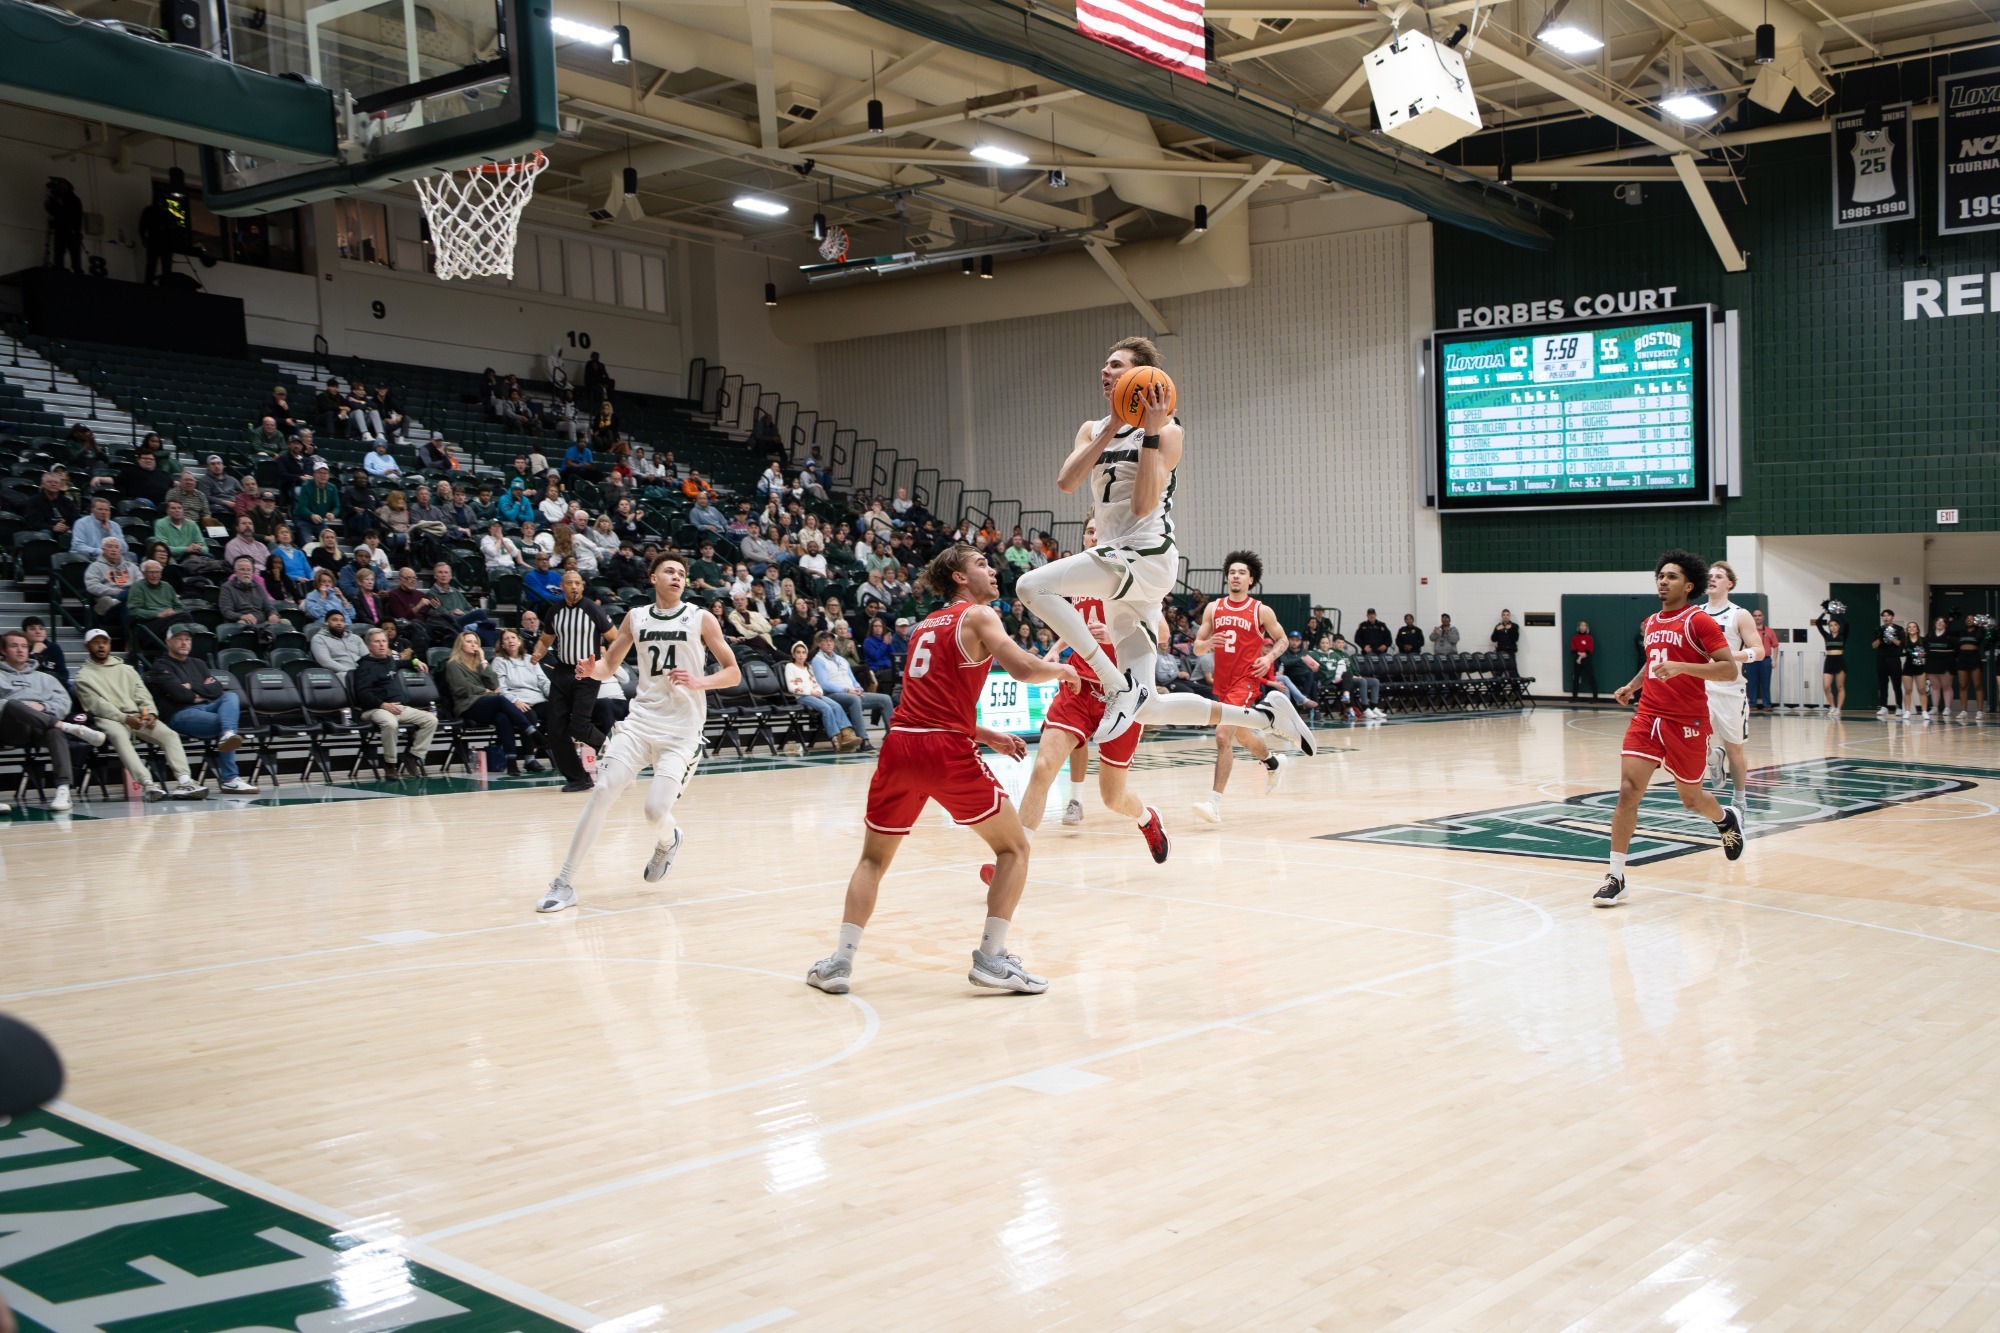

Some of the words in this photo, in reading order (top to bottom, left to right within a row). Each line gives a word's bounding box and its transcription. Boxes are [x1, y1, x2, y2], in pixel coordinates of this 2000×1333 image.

[1860, 157, 1886, 176] 25
[1841, 201, 1906, 220] 1986-1990
[371, 300, 386, 320] 9
[1458, 299, 1565, 328] FORBES
[1574, 286, 1677, 317] COURT
[566, 330, 591, 349] 10
[1600, 338, 1618, 360] 55
[1634, 332, 1681, 352] BOSTON
[1544, 338, 1579, 361] 5:58
[1636, 349, 1679, 359] UNIVERSITY
[1638, 398, 1646, 408] 13
[1639, 413, 1646, 423] 12
[1568, 433, 1577, 442] 14
[1638, 429, 1646, 439] 18
[1653, 428, 1660, 438] 10
[1568, 448, 1578, 458] 20
[1451, 469, 1460, 478] 24
[1568, 464, 1576, 473] 21
[1466, 482, 1481, 492] 42.3
[1509, 480, 1517, 491] 31
[1632, 475, 1641, 486] 31
[1677, 473, 1688, 485] 14
[1940, 511, 1955, 521] EXIT
[1215, 616, 1252, 632] BOSTON
[1224, 629, 1237, 653] 2
[648, 645, 677, 676] 24
[908, 631, 936, 679] 6
[990, 681, 1018, 707] 5:58
